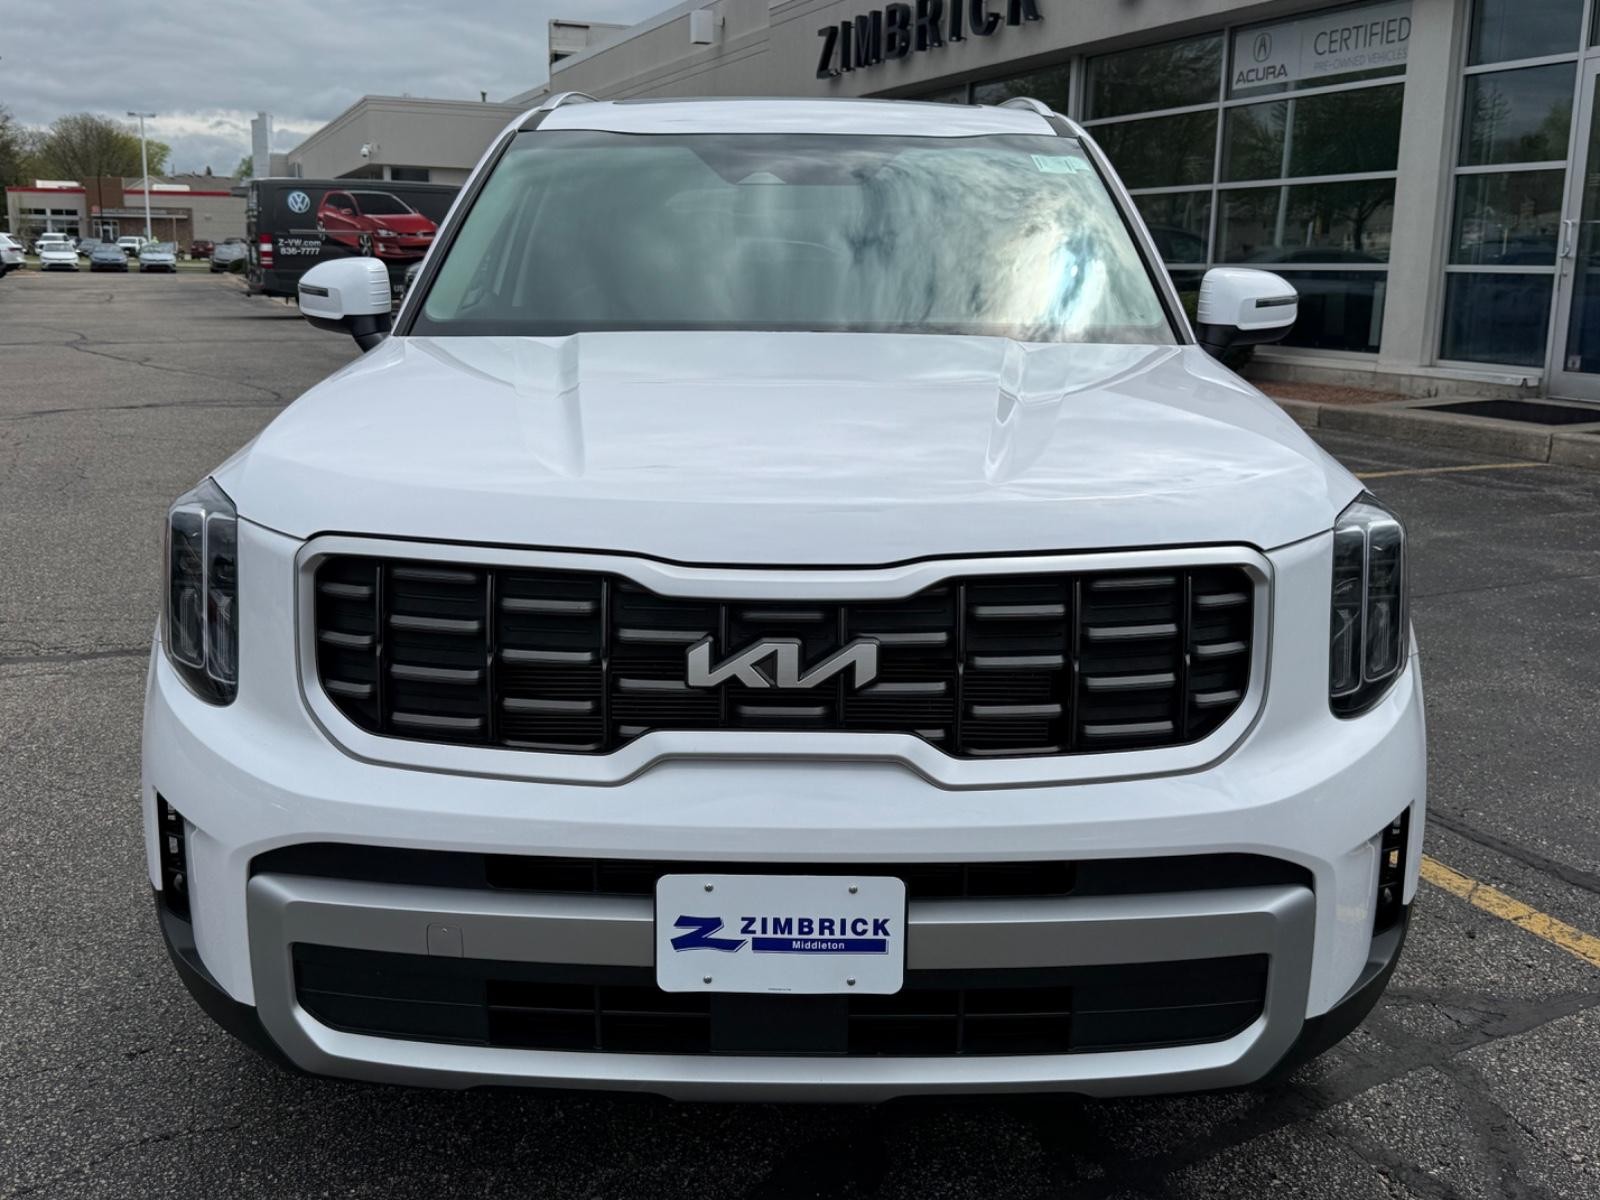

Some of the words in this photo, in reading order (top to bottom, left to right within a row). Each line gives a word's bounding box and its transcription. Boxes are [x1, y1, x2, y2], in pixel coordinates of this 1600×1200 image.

[1314, 17, 1412, 56] CERTIFIED
[1313, 54, 1366, 72] PRE-OWNED
[1367, 48, 1408, 66] VEHICLES
[1235, 64, 1288, 85] ACURA
[740, 916, 890, 936] ZIMBRICK
[792, 940, 845, 950] Middleton
